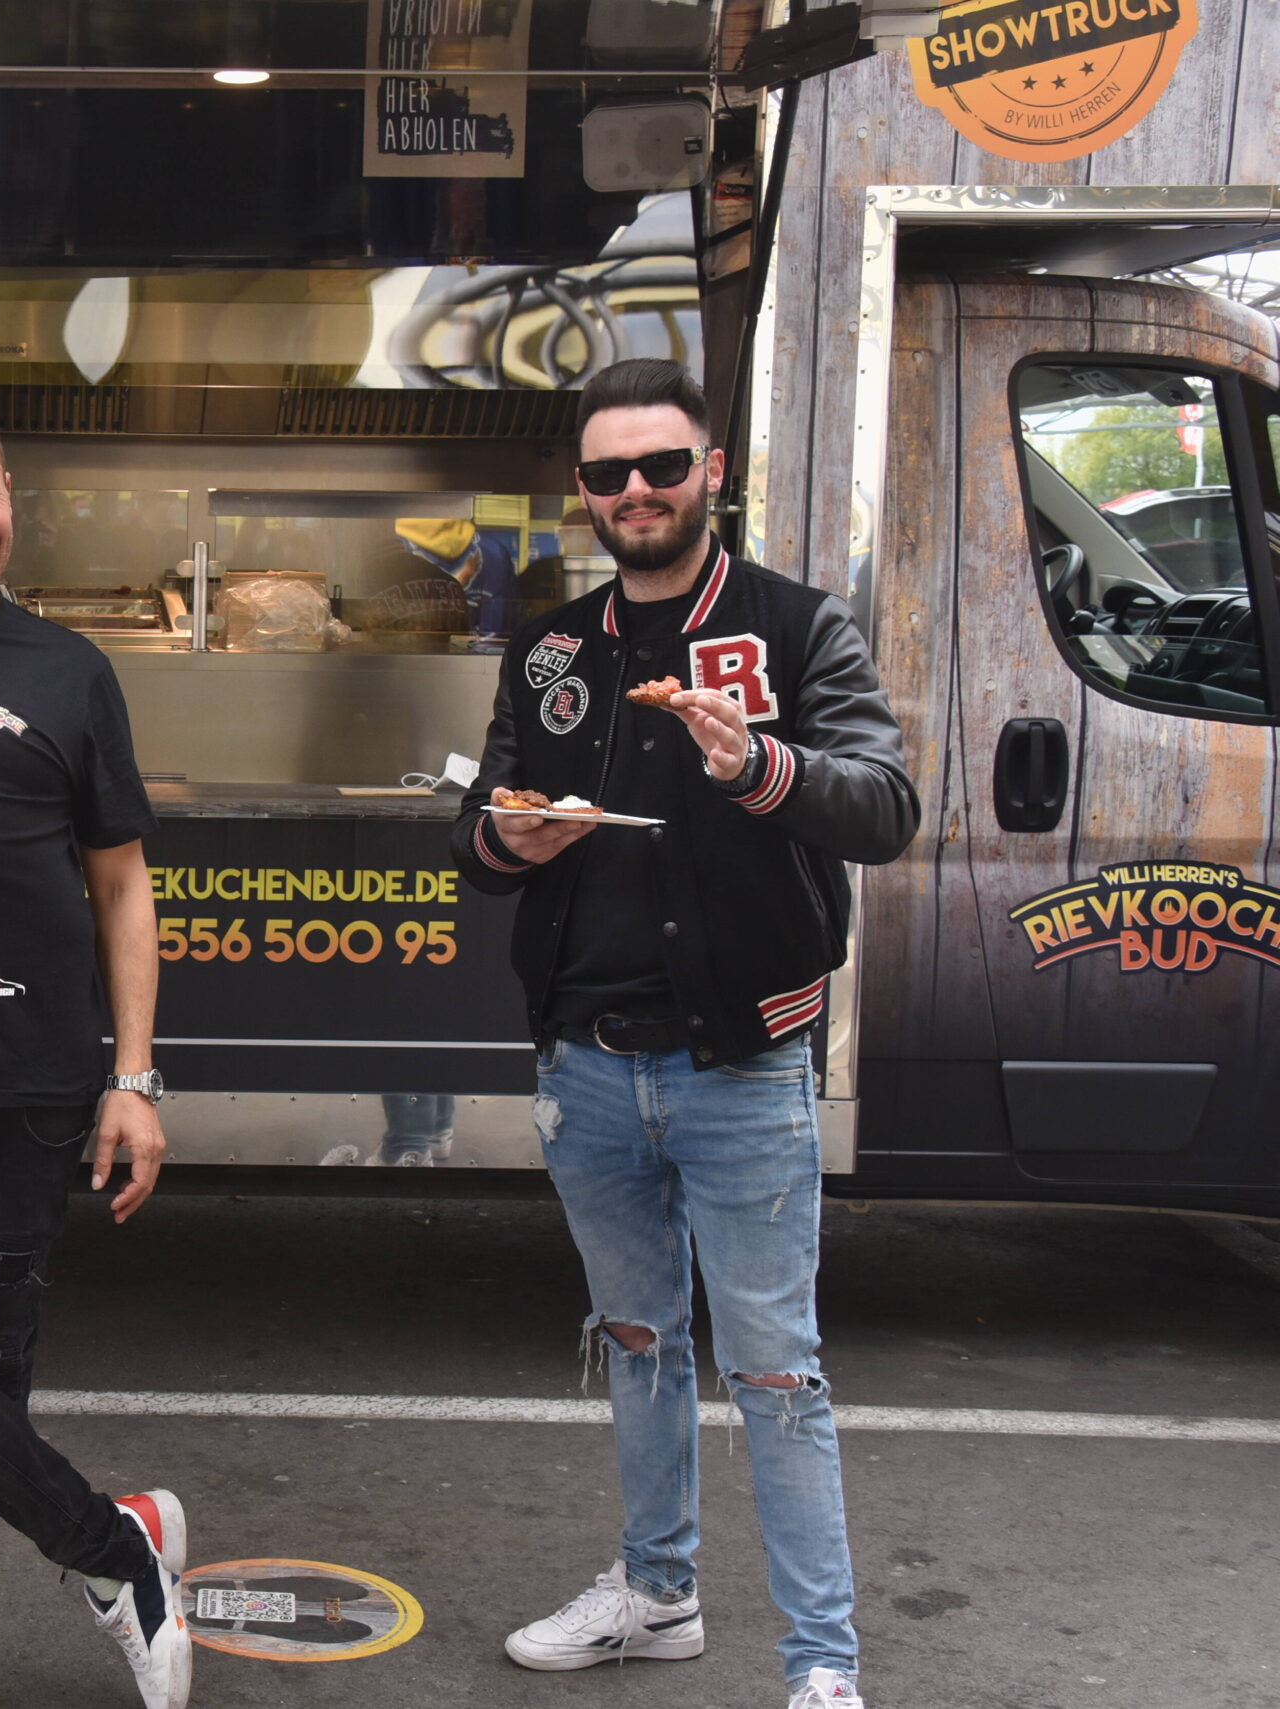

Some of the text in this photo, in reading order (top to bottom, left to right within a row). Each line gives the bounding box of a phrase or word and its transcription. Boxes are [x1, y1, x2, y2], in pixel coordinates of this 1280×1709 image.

[929, 0, 1172, 70] SHOWTRUCK
[386, 78, 430, 113] HIER
[1004, 81, 1122, 129] BY WILLI HERREN
[384, 116, 476, 150] ABHOLEN
[530, 651, 567, 673] BENLEE
[691, 635, 776, 721] R
[544, 680, 585, 710] ROCKY MARCIANO
[552, 691, 575, 719] BL
[148, 866, 459, 903] EKUCHENBUDE.DE
[1101, 863, 1239, 889] WILLI HERREN'S
[158, 917, 252, 962] 556
[264, 918, 383, 963] 500
[395, 920, 457, 964] 95
[1120, 928, 1219, 972] BUD
